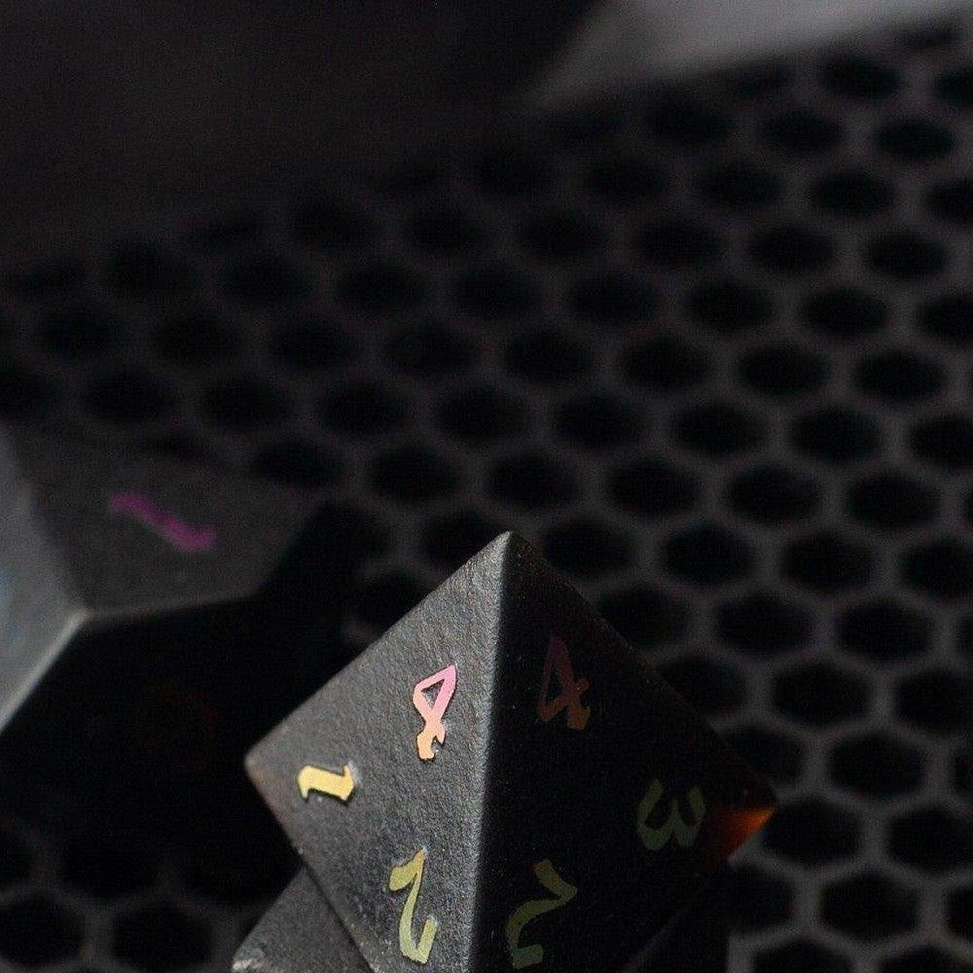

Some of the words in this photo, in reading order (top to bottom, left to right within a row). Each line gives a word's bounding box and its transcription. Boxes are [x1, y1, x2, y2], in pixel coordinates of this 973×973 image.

[108, 492, 216, 552] 1
[411, 664, 458, 760] 4
[535, 636, 593, 732] 4
[297, 763, 356, 803] 1
[637, 779, 708, 852] 3
[387, 847, 438, 965] 2
[504, 860, 579, 970] 2
